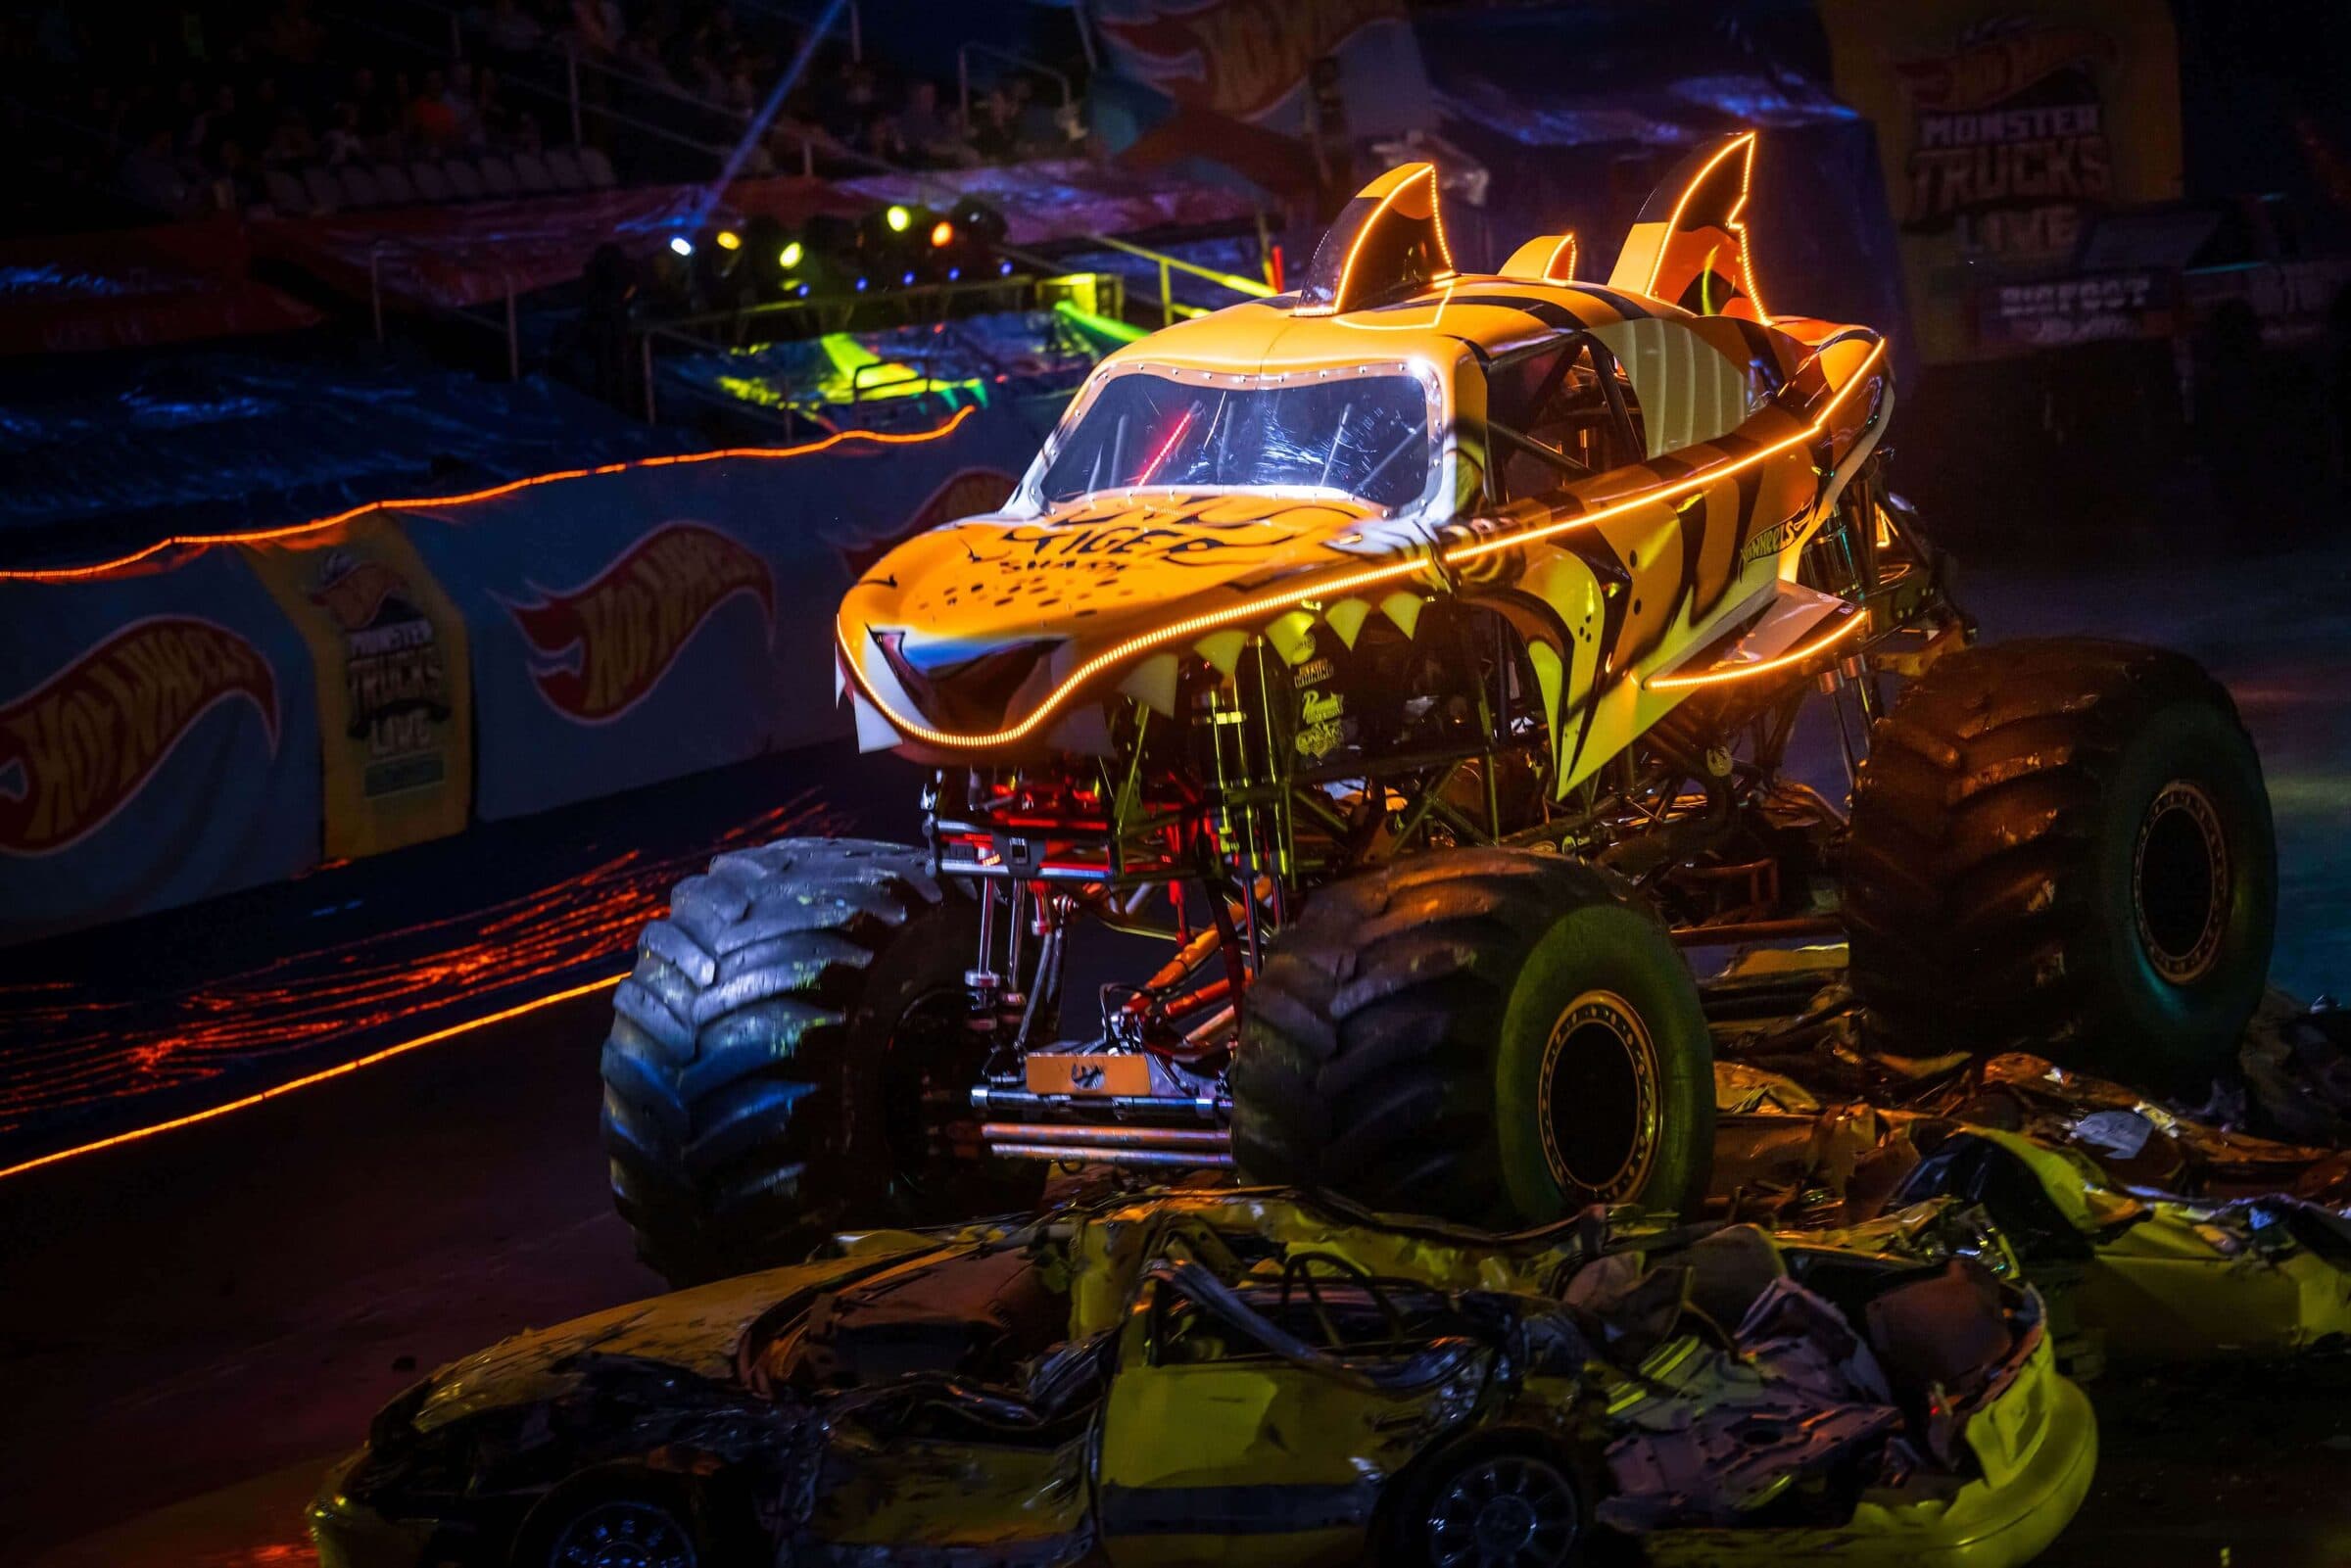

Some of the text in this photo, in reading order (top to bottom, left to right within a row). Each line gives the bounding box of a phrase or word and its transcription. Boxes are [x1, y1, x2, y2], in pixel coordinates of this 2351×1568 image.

[1920, 103, 2101, 147] MONSTER
[1906, 135, 2113, 219] TRUCKS
[1954, 205, 2077, 256] LIVE
[1001, 527, 1225, 566] TIGER
[570, 584, 652, 711] HOT
[5, 691, 118, 840] HOT
